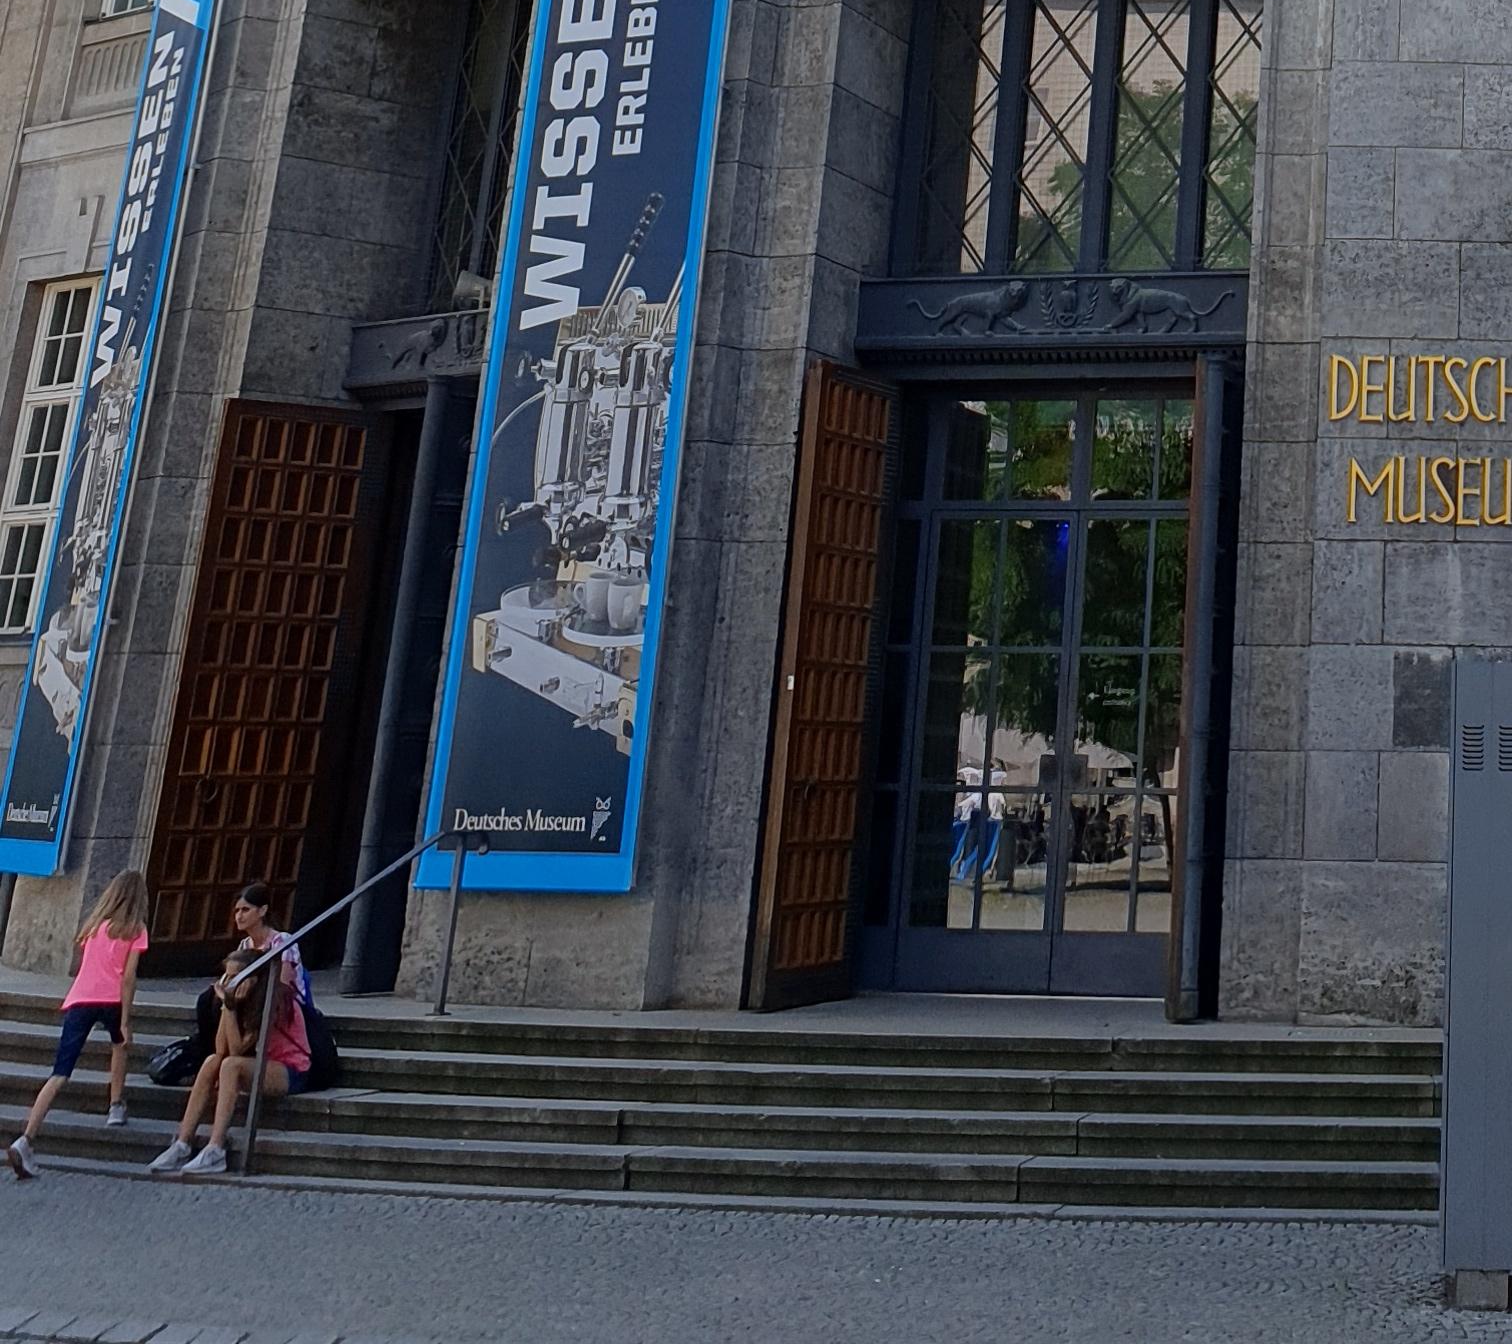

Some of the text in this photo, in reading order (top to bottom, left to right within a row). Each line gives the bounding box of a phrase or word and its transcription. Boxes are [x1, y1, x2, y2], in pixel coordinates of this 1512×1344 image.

[90, 30, 176, 389] WISSEN
[141, 46, 185, 233] ERLEBEN
[453, 807, 586, 832] Deutsches Museum
